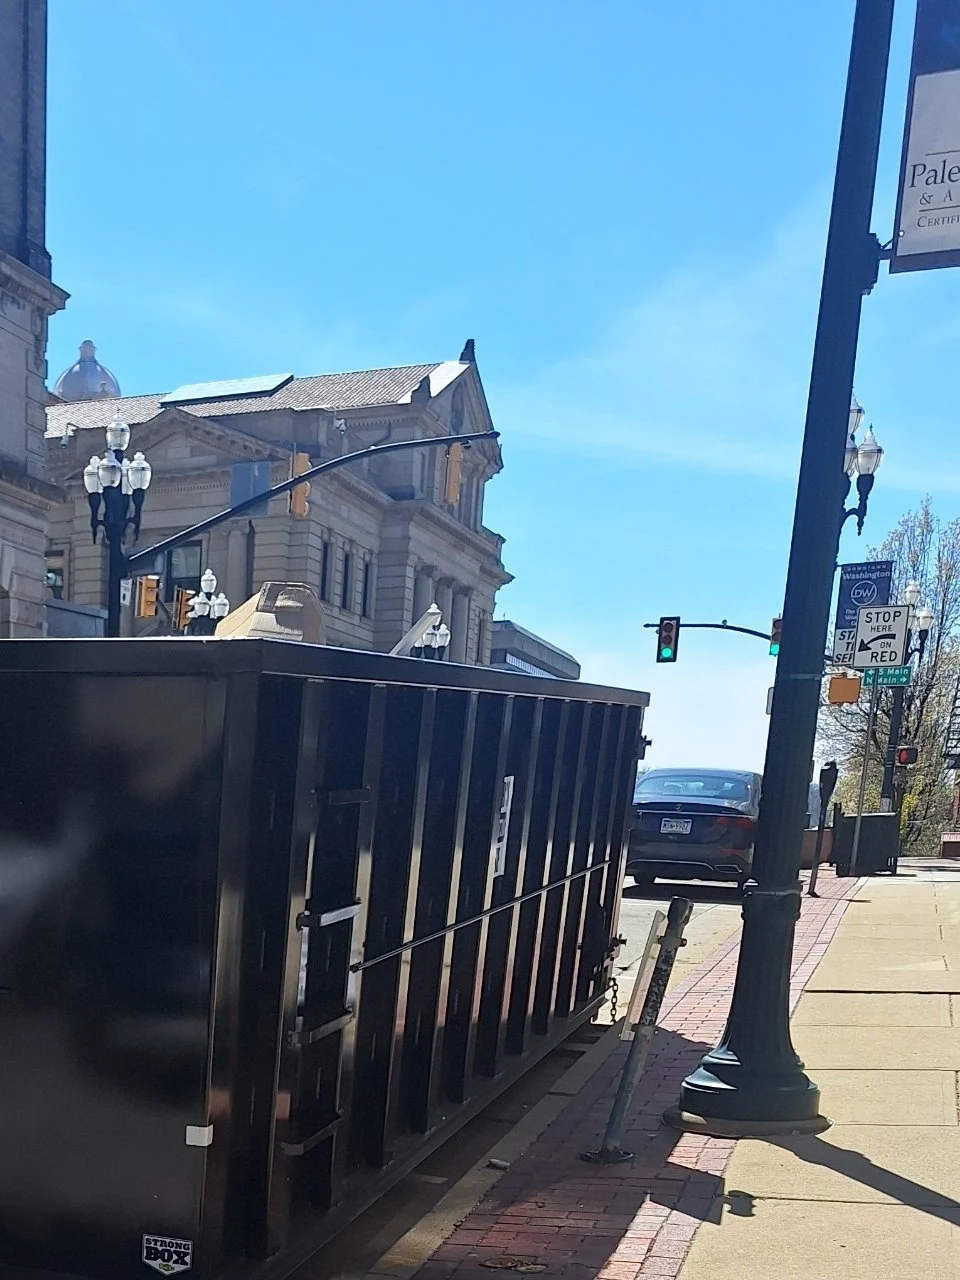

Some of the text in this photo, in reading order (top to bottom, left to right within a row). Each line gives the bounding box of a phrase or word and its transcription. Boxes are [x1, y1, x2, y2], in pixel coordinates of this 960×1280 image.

[920, 192, 934, 205] &
[842, 570, 891, 580] Washington
[865, 610, 902, 624] STOP
[870, 625, 893, 633] HERE
[870, 651, 898, 663] RED
[887, 667, 909, 675] Main
[146, 1238, 190, 1250] STRONG
[144, 1246, 190, 1266] BOX
